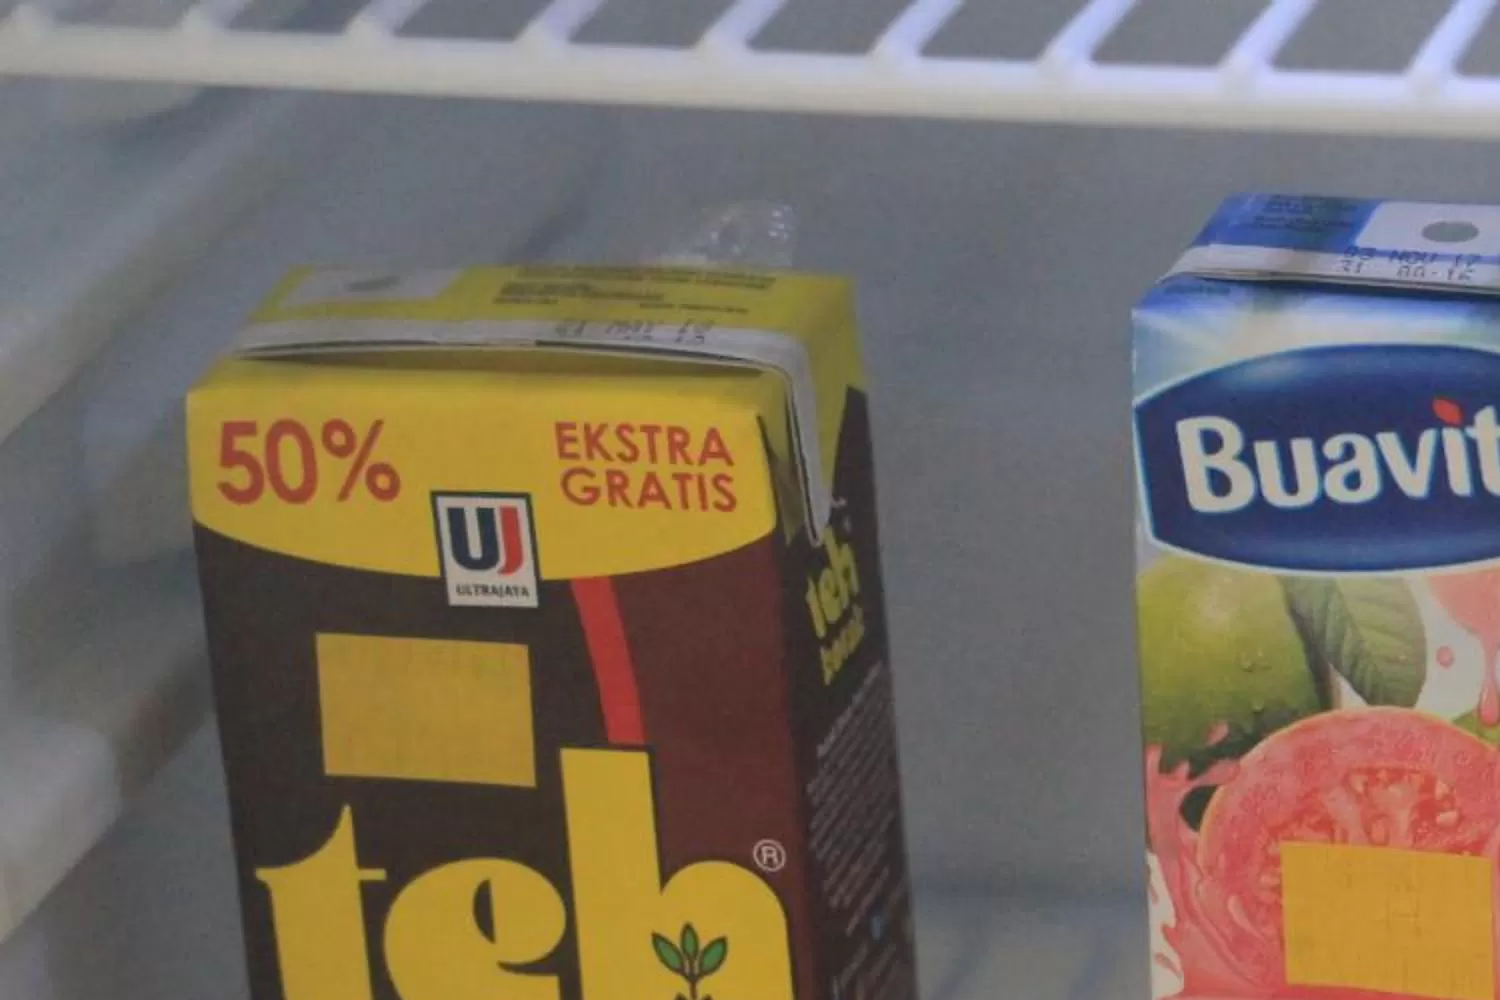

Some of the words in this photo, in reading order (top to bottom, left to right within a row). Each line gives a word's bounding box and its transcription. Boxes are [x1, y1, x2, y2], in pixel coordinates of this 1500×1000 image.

[216, 418, 401, 504] 50%
[555, 421, 735, 467] EKSTRA
[560, 466, 738, 513] GRATIS
